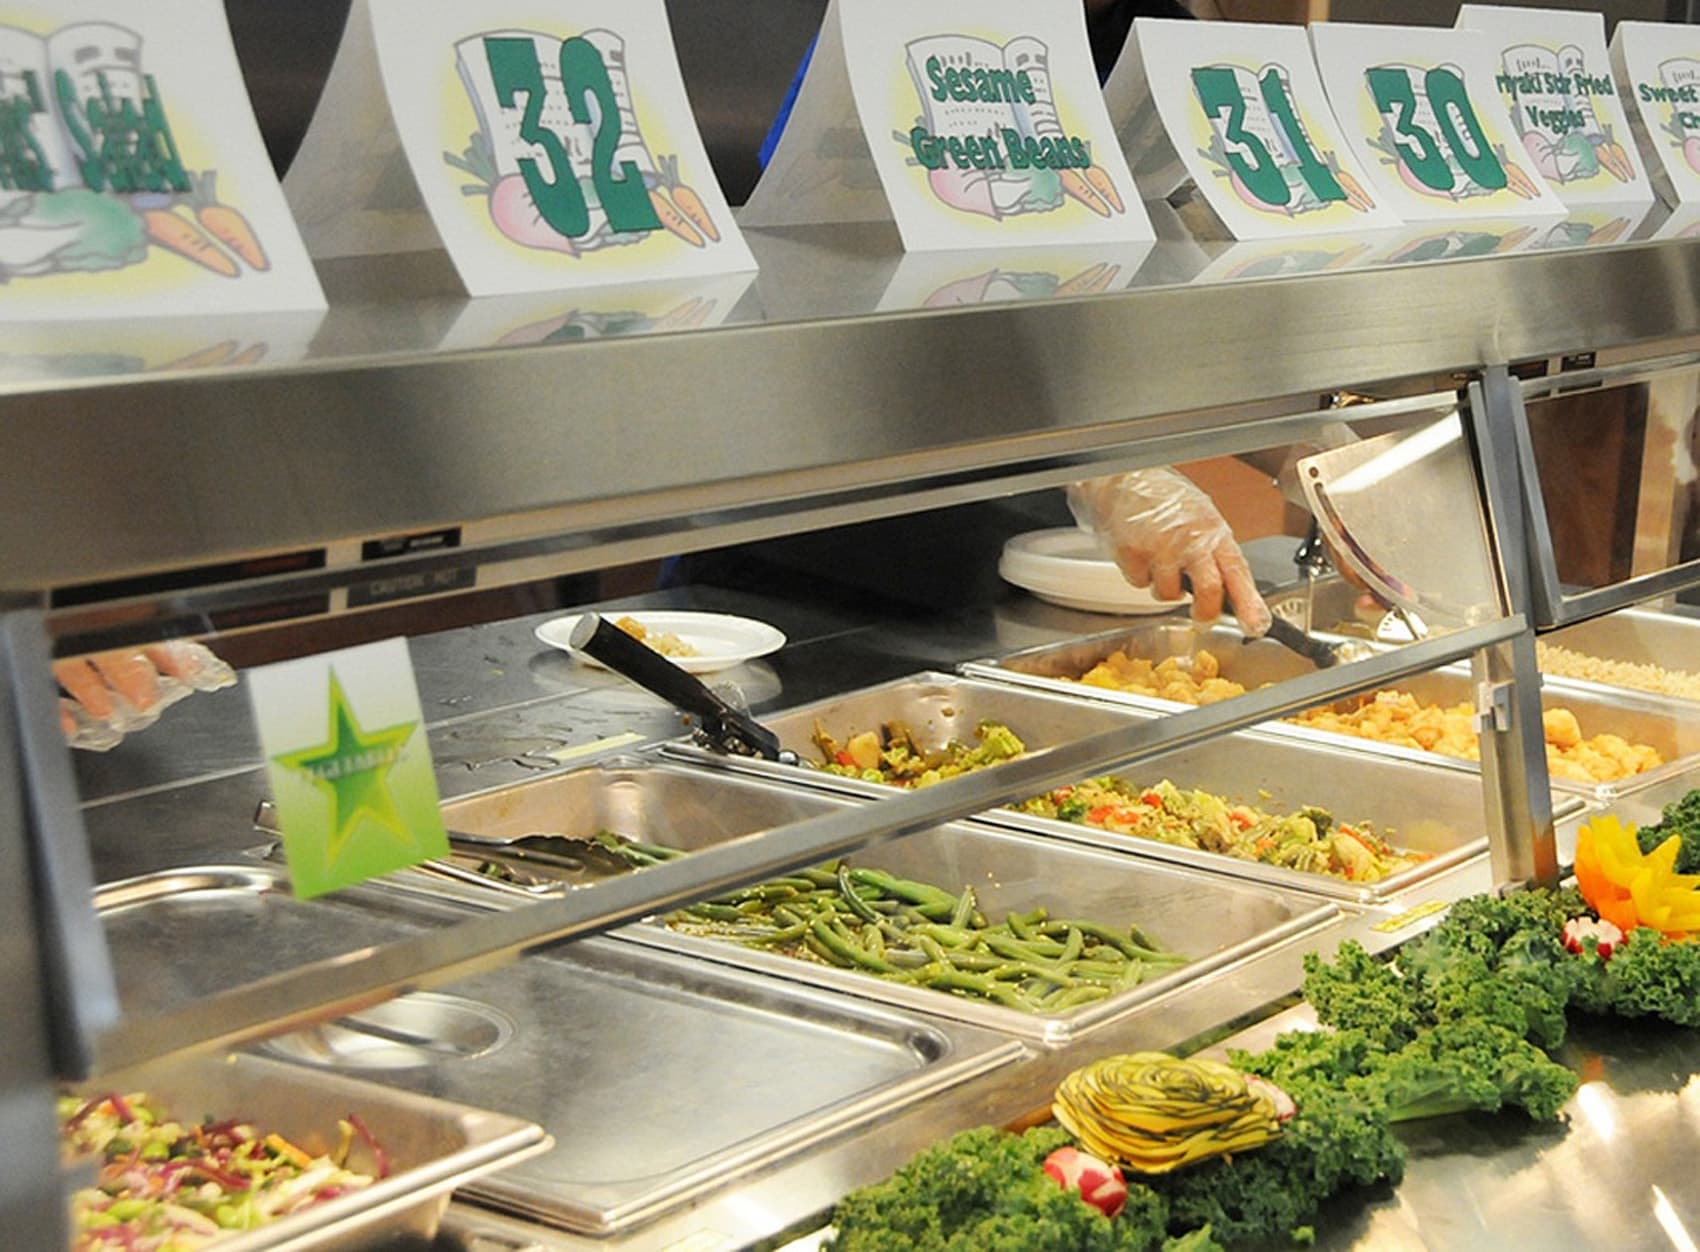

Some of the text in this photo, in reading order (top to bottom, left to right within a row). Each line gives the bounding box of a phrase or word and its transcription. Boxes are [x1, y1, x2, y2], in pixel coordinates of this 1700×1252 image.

[926, 55, 1036, 104] Sesame
[1638, 83, 1699, 103] Sweet
[483, 36, 665, 237] 32
[1191, 68, 1348, 206] 31
[1366, 68, 1508, 190] 30
[1525, 104, 1585, 135] Veggies
[910, 126, 1091, 170] Green Beans
